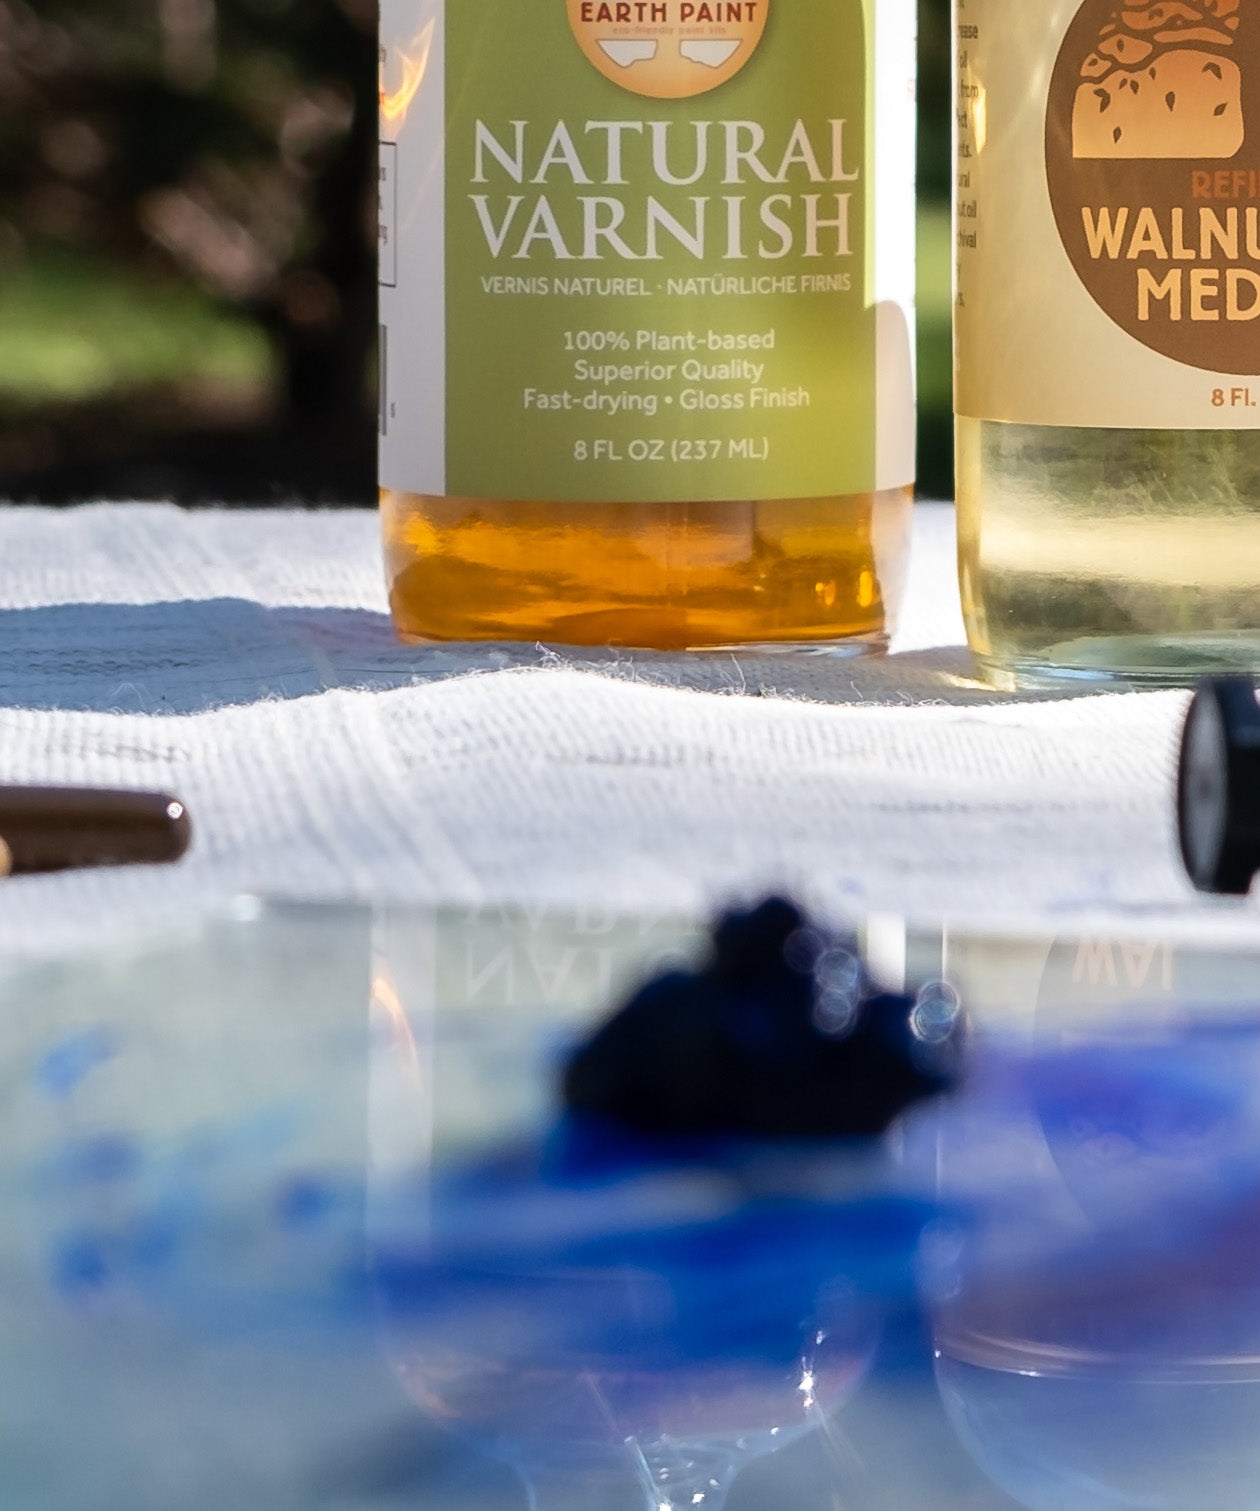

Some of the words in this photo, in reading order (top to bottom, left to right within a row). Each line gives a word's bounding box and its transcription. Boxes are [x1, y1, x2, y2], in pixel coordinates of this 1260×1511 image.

[580, 2, 667, 23] EARTH
[680, 2, 757, 22] PAINT
[469, 118, 859, 185] NATURAL
[468, 193, 854, 260] VARNISH
[480, 275, 549, 294] VERNIS
[553, 277, 652, 296] NATUREL
[667, 273, 798, 295] NATÜRLICHE
[801, 273, 852, 293] FIRNIS
[564, 330, 630, 351] 100%
[636, 328, 776, 351] Plant-based
[574, 359, 676, 385] Superior
[681, 358, 764, 384] Quality
[523, 388, 658, 416] Fast-drying
[679, 388, 744, 411] Gloss
[750, 386, 810, 409] Finish
[1211, 387, 1225, 407] 8
[573, 440, 587, 461] 8
[594, 440, 622, 461] FL
[628, 439, 664, 461] OZ
[671, 438, 720, 463] (237
[728, 436, 769, 460] ML)
